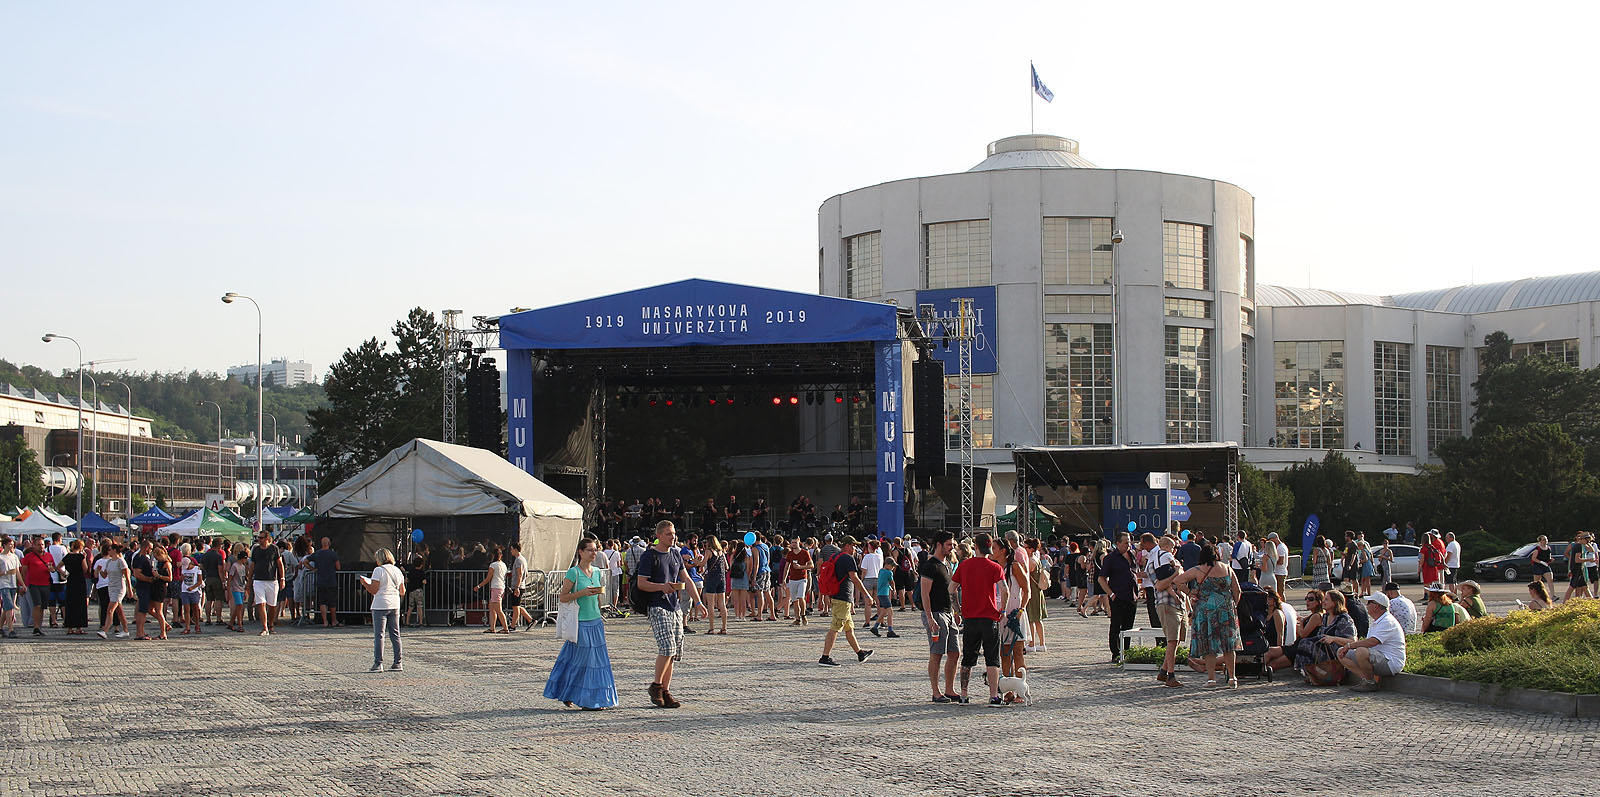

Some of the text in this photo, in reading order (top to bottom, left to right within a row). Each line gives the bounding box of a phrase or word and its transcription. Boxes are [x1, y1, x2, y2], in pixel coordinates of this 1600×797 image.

[641, 303, 748, 320] MASARYKOVA
[765, 310, 807, 324] 2019
[585, 315, 625, 328] 1919
[642, 320, 748, 335] UNIVERZITA
[882, 391, 896, 503] MUNI
[1111, 494, 1160, 510] MUNI
